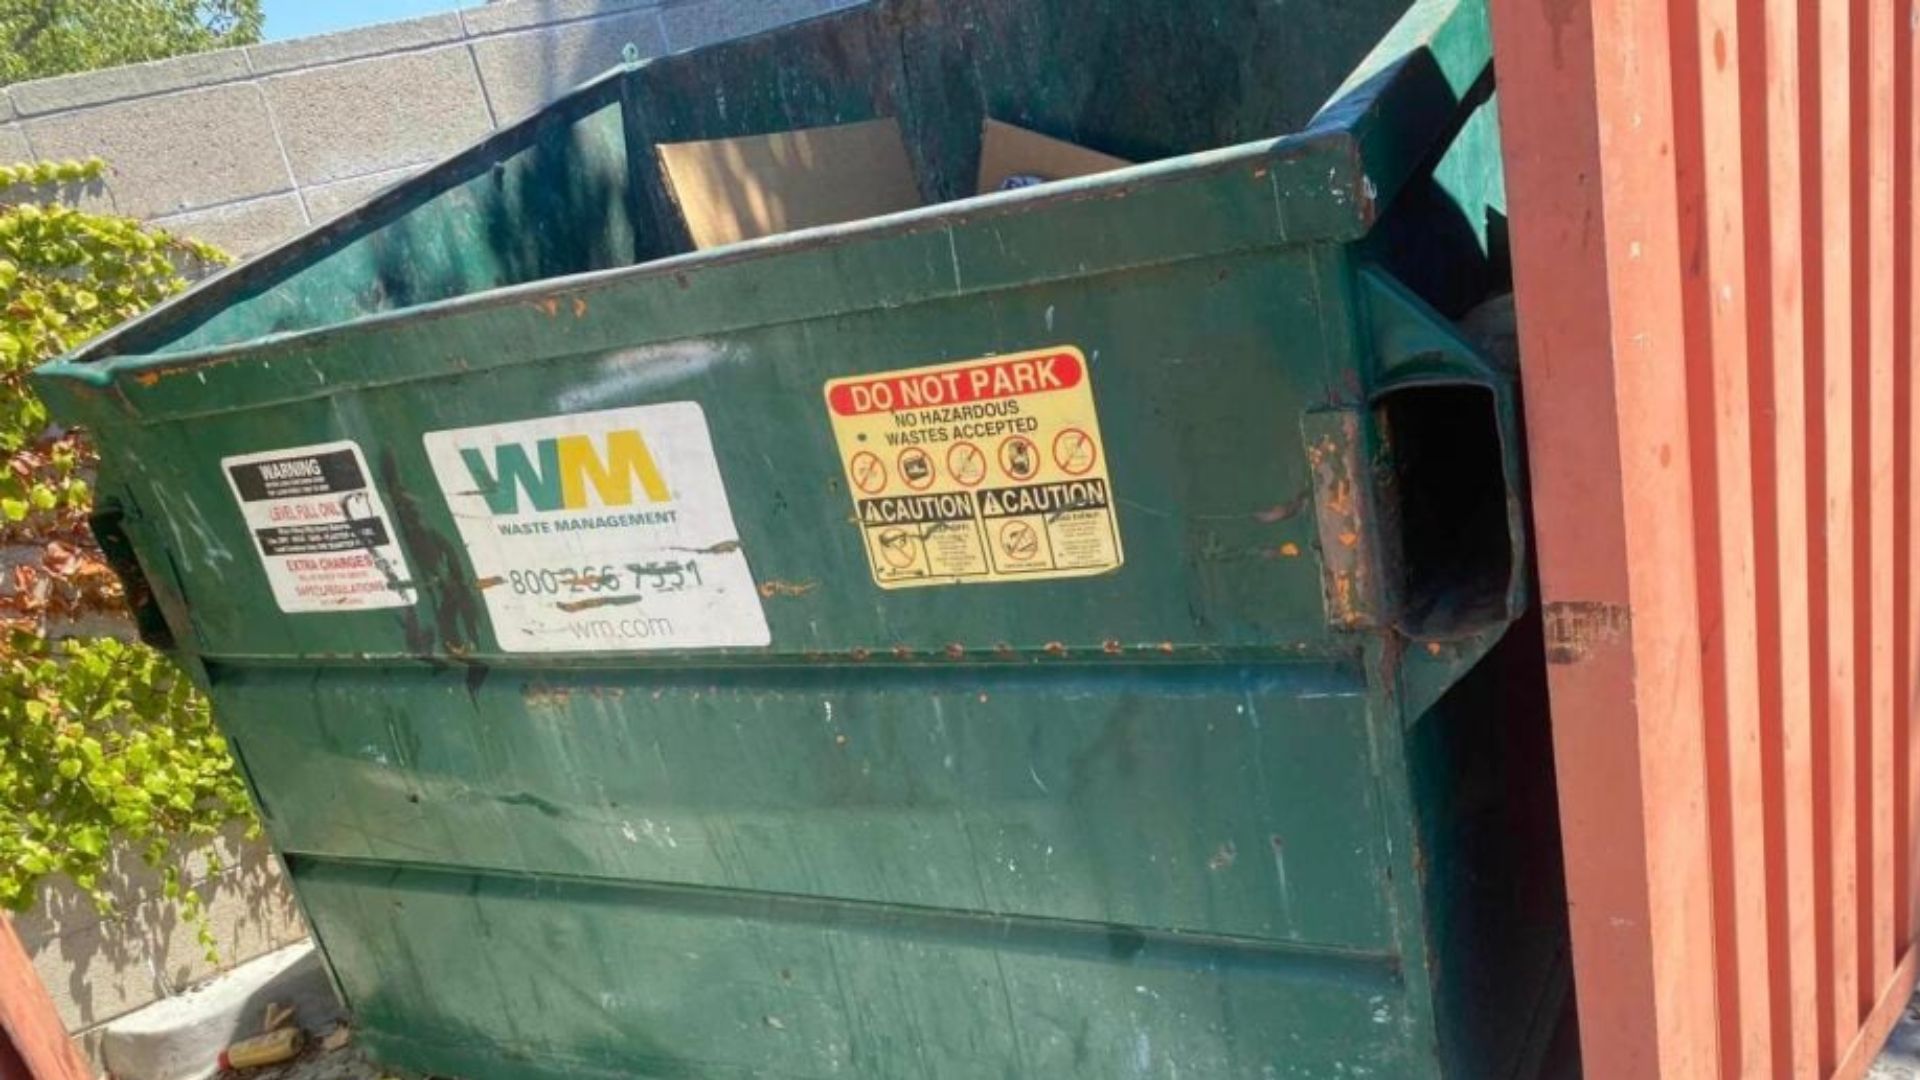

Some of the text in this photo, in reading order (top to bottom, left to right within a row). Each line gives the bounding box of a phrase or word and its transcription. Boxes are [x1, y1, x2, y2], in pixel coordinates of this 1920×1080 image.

[851, 358, 1062, 412] DO NOT PARK
[895, 399, 1020, 428] NO HAZARDOUS
[885, 416, 1039, 447] WASTES ACCEPTED
[259, 458, 321, 480] WARNING
[458, 429, 671, 516] WM
[880, 494, 973, 522] CAUTION
[1001, 481, 1105, 512] CAUTION
[497, 509, 678, 536] WASTE MANAGEMENT
[286, 554, 374, 571] EXTRA CHARGES
[510, 568, 558, 595] 800
[569, 617, 673, 639] wm.com
